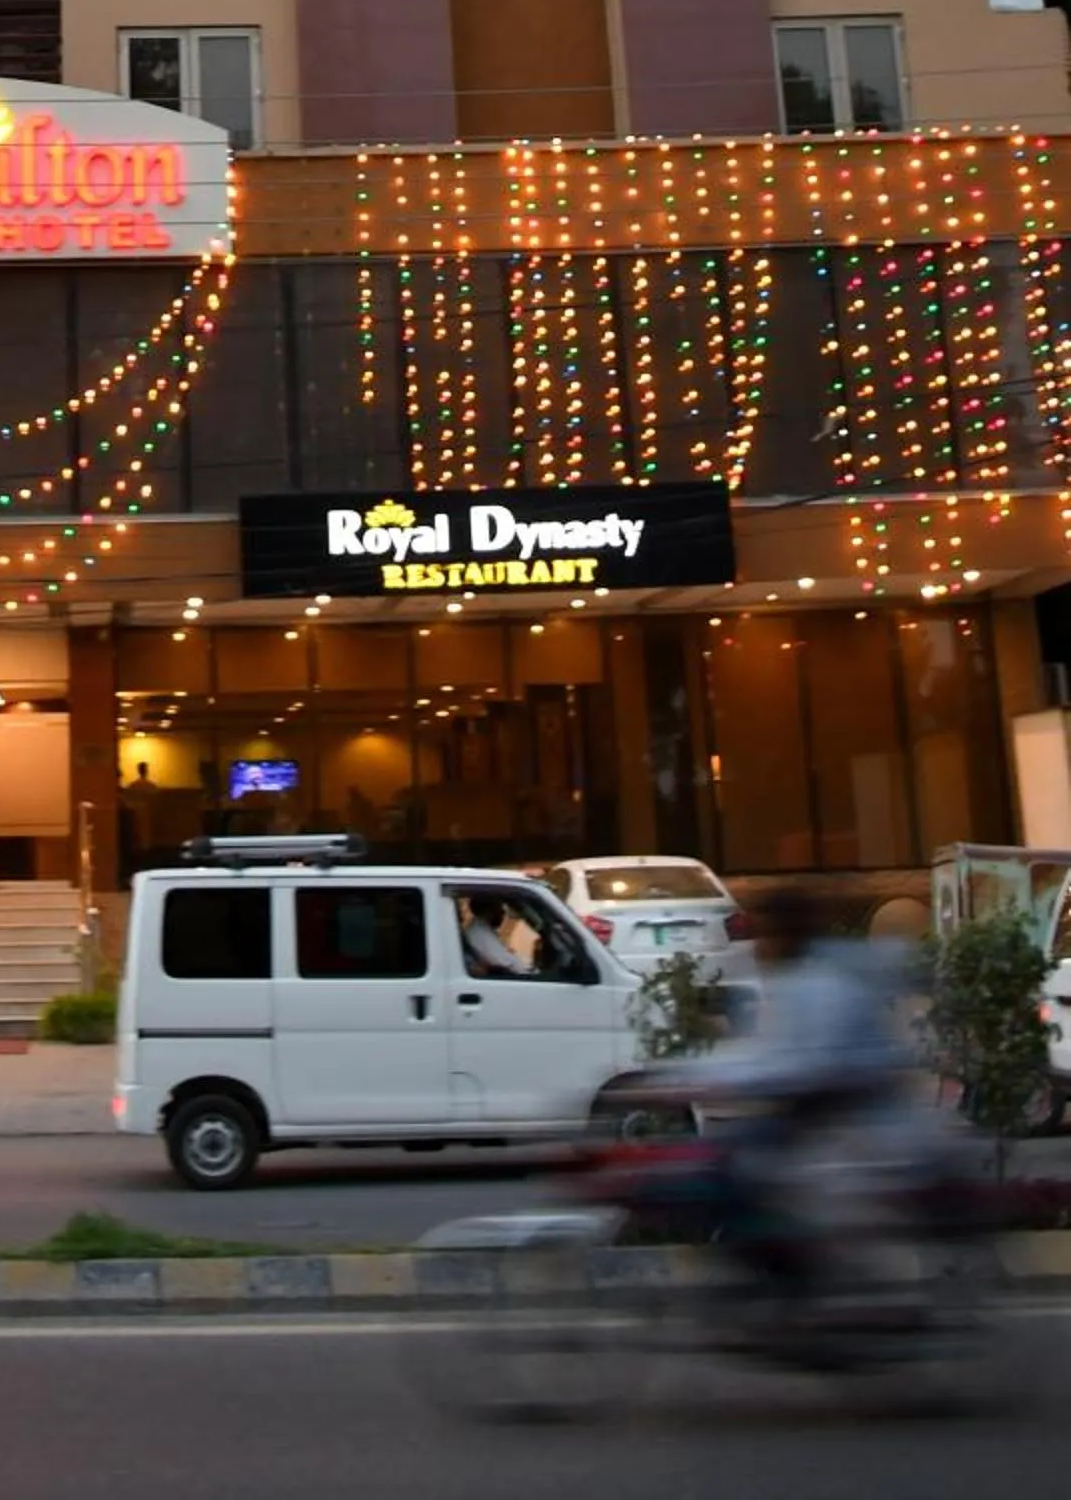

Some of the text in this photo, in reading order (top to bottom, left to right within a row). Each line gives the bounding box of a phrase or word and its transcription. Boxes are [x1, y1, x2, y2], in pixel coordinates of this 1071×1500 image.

[328, 504, 645, 561] Royal Dynasty
[381, 558, 599, 590] RESTAURANT
